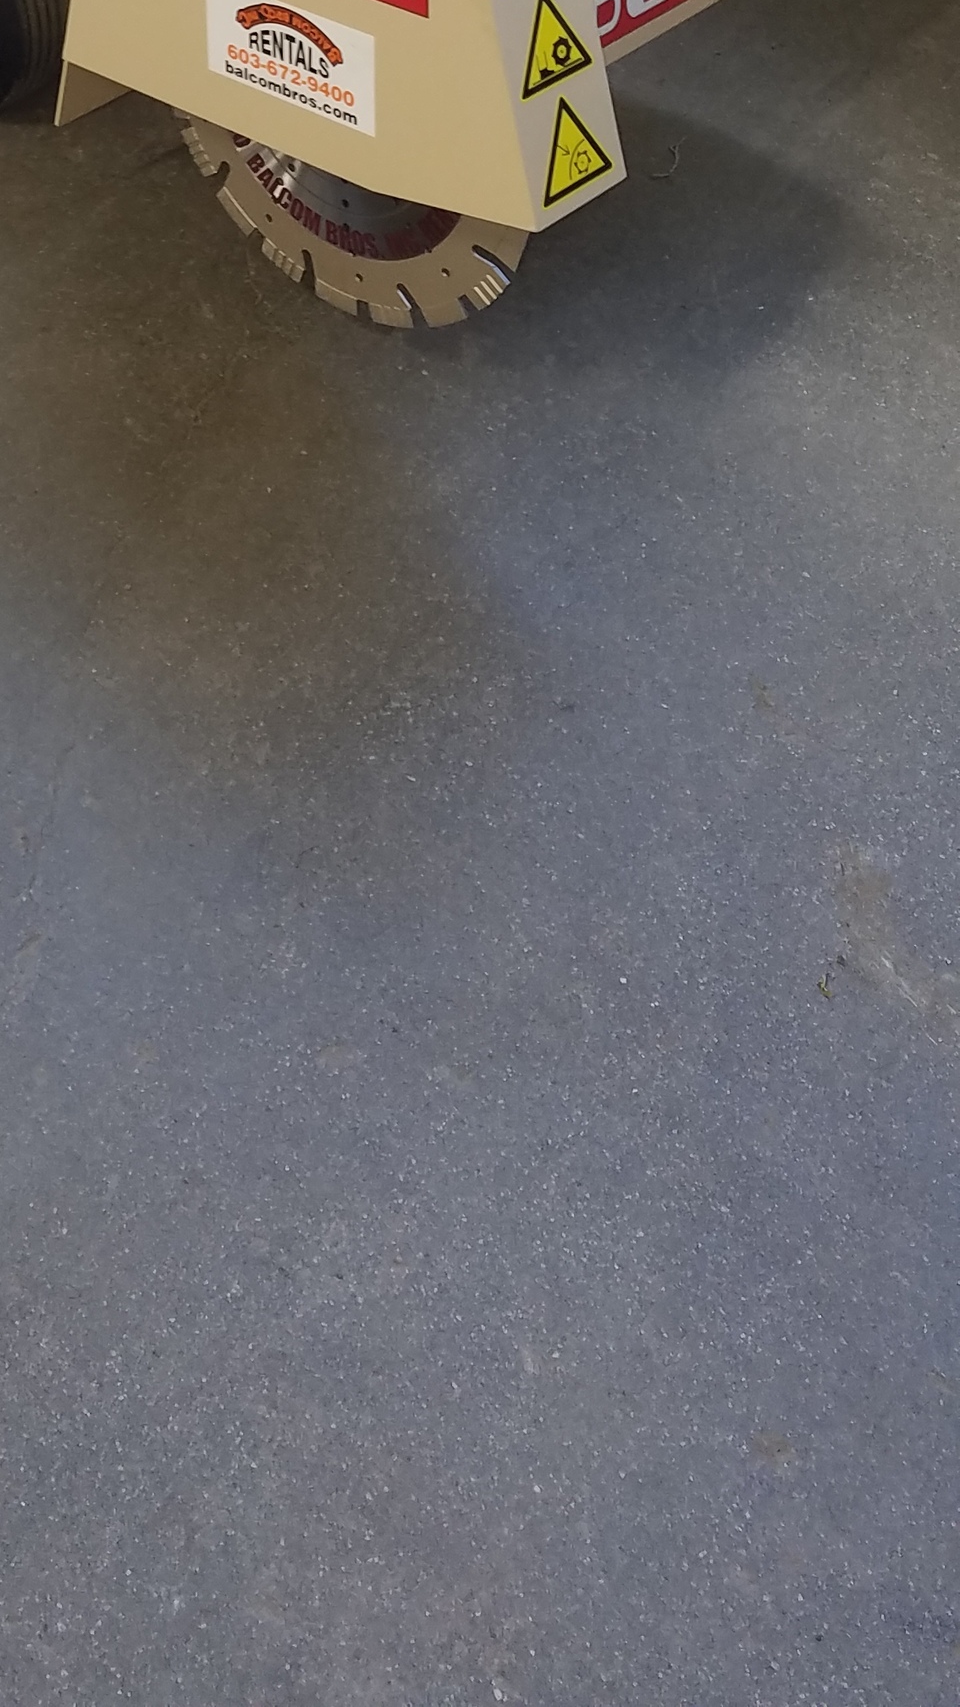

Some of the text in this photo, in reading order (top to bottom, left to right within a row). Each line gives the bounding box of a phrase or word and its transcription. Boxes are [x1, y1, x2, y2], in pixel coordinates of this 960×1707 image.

[227, 44, 355, 107] 603-672-9400
[248, 29, 329, 78] RENTALS
[225, 60, 358, 125] balcombros.com
[246, 153, 322, 236] BALCOM
